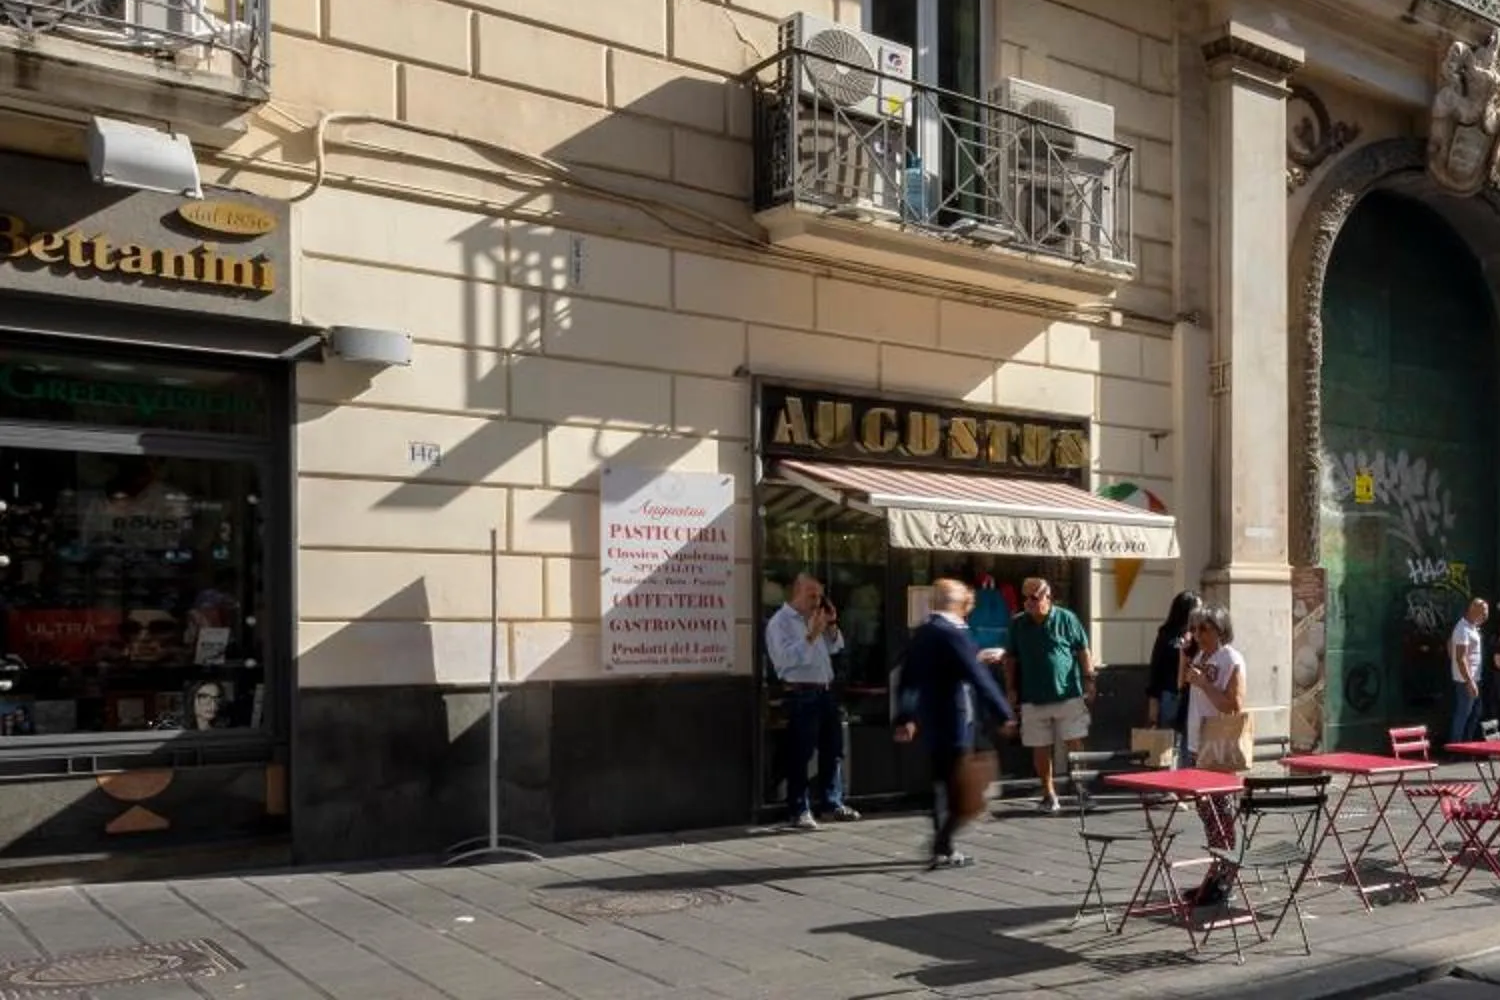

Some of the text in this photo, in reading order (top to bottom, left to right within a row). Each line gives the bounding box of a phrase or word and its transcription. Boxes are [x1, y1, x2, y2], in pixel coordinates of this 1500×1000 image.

[0, 212, 275, 292] Bettanini
[772, 396, 1089, 469] AUGUSTUS
[609, 523, 728, 543] PASTICCERIA
[933, 512, 1149, 553] Gastronomia Pasticceria
[609, 619, 727, 633] GASTRONOMIA
